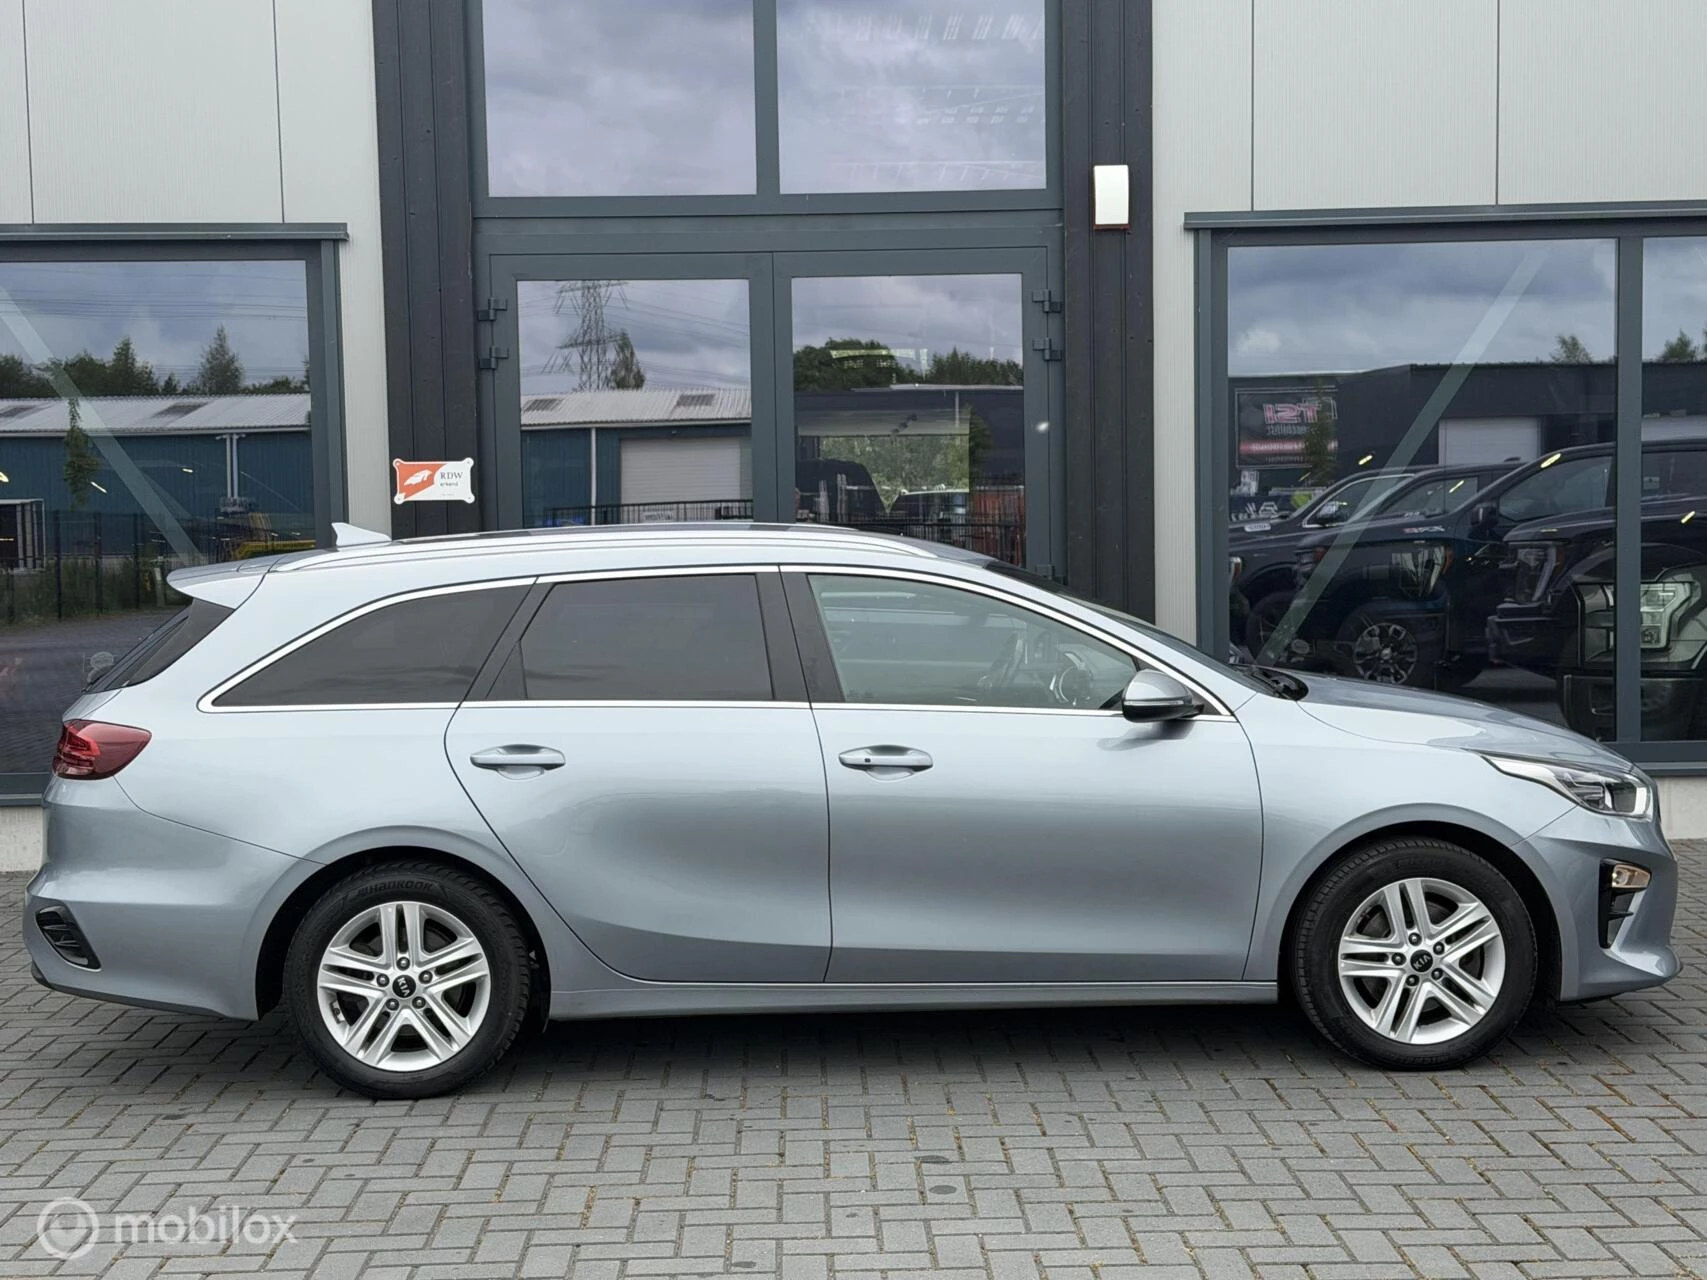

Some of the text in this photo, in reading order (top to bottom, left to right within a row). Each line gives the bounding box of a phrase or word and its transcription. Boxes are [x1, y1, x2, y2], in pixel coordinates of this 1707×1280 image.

[440, 471, 463, 480] RDW
[1413, 954, 1431, 970] KIA
[398, 977, 410, 997] KIA
